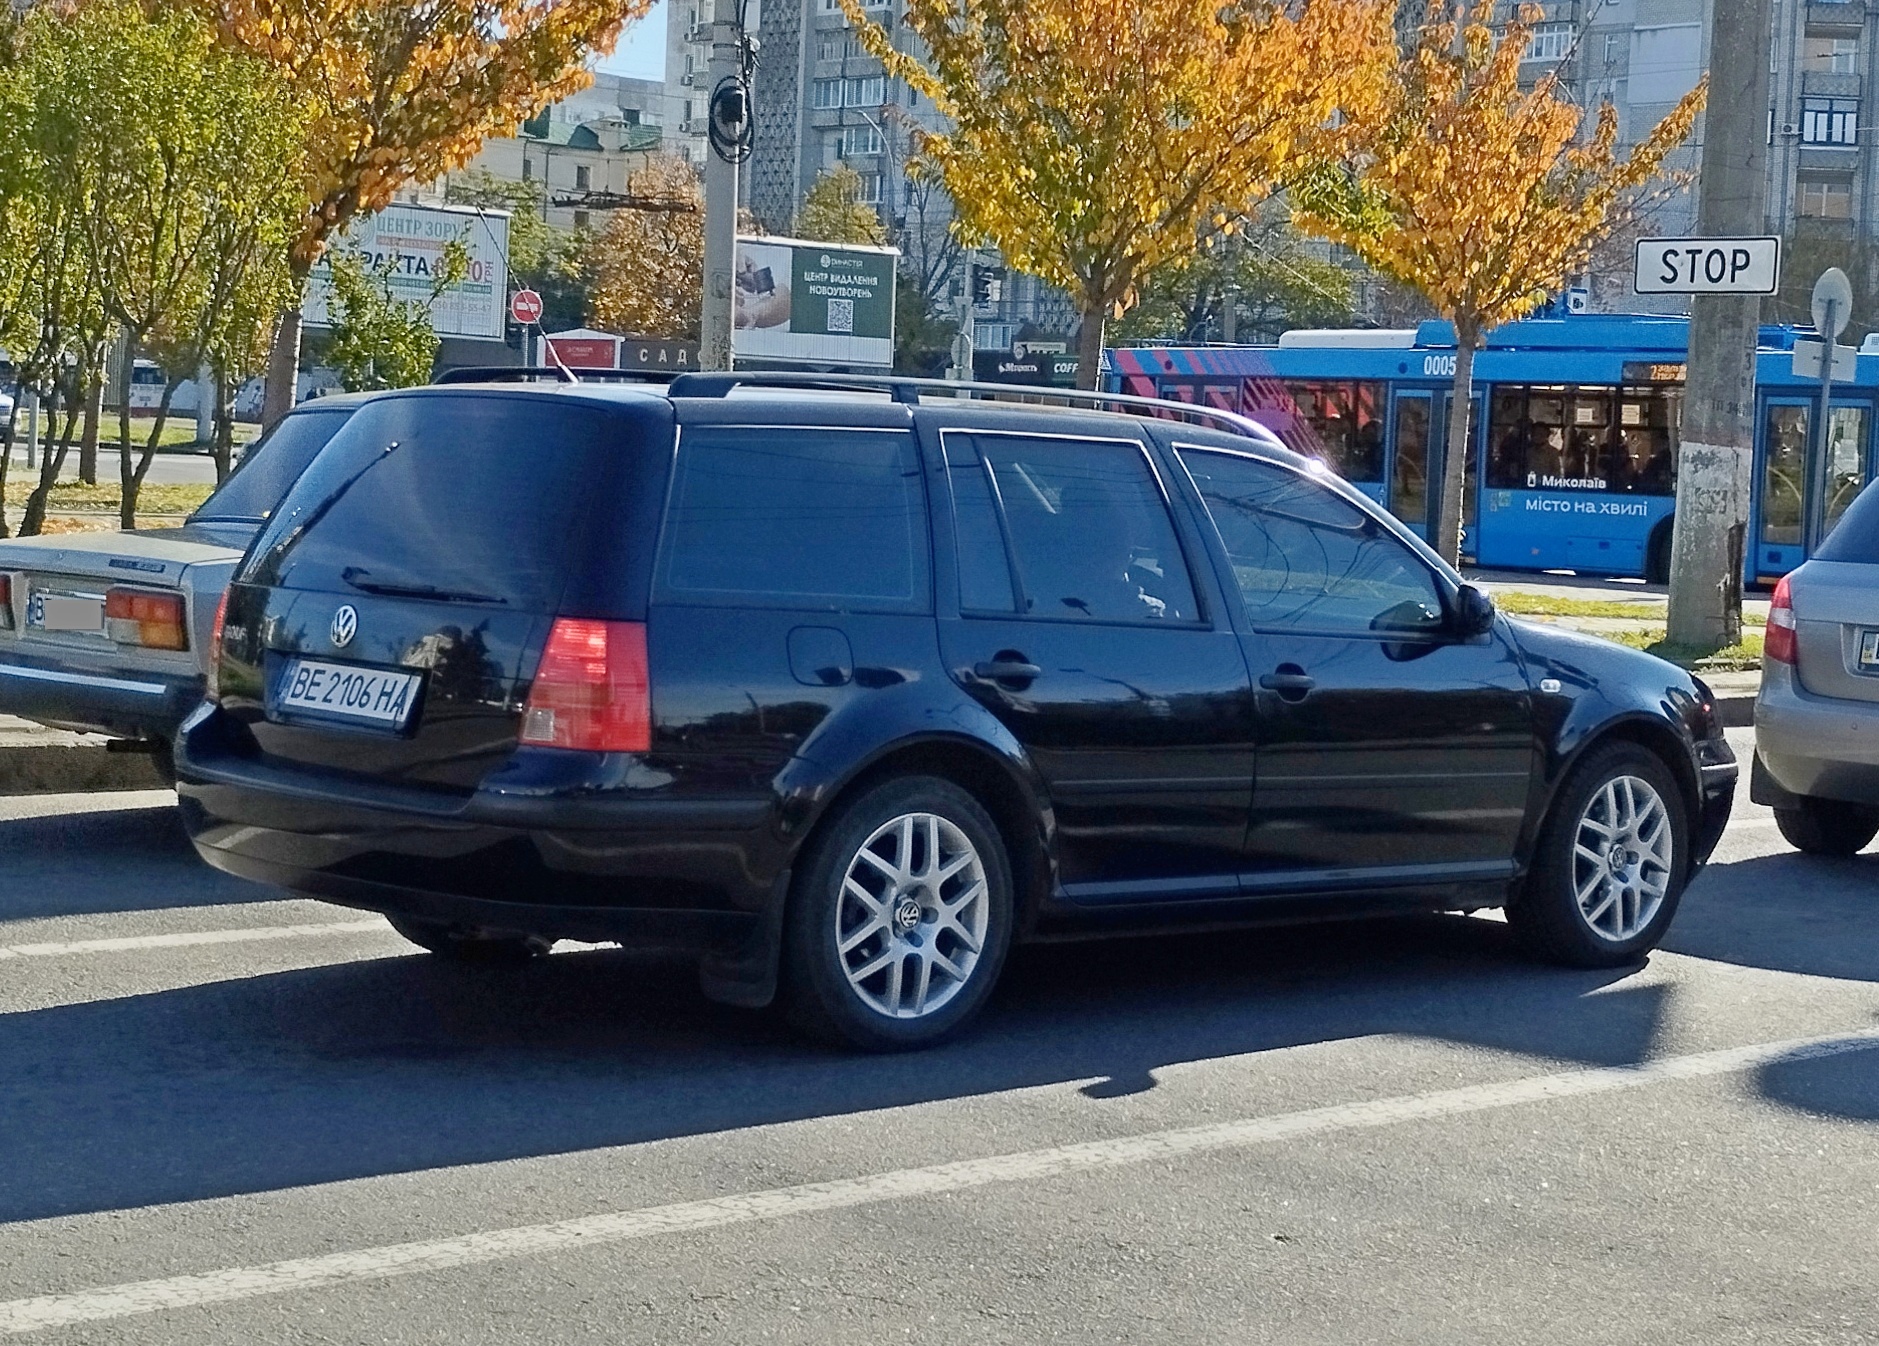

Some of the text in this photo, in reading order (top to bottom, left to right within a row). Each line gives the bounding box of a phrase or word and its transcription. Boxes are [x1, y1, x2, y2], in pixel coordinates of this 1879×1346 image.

[377, 217, 460, 241] ЦЕНТР ЗОРУ
[1659, 248, 1750, 284] STOP
[804, 271, 878, 286] ЦЕНТР ВИДАЛЕННЯ
[809, 285, 872, 298] НОВОУТВОРЕНЬ
[639, 348, 702, 365] САД
[1424, 355, 1457, 376] 0005
[1541, 475, 1607, 489] Миколаїв
[1525, 496, 1648, 516] місто на хвилі
[290, 667, 412, 715] BE 2106 HA
